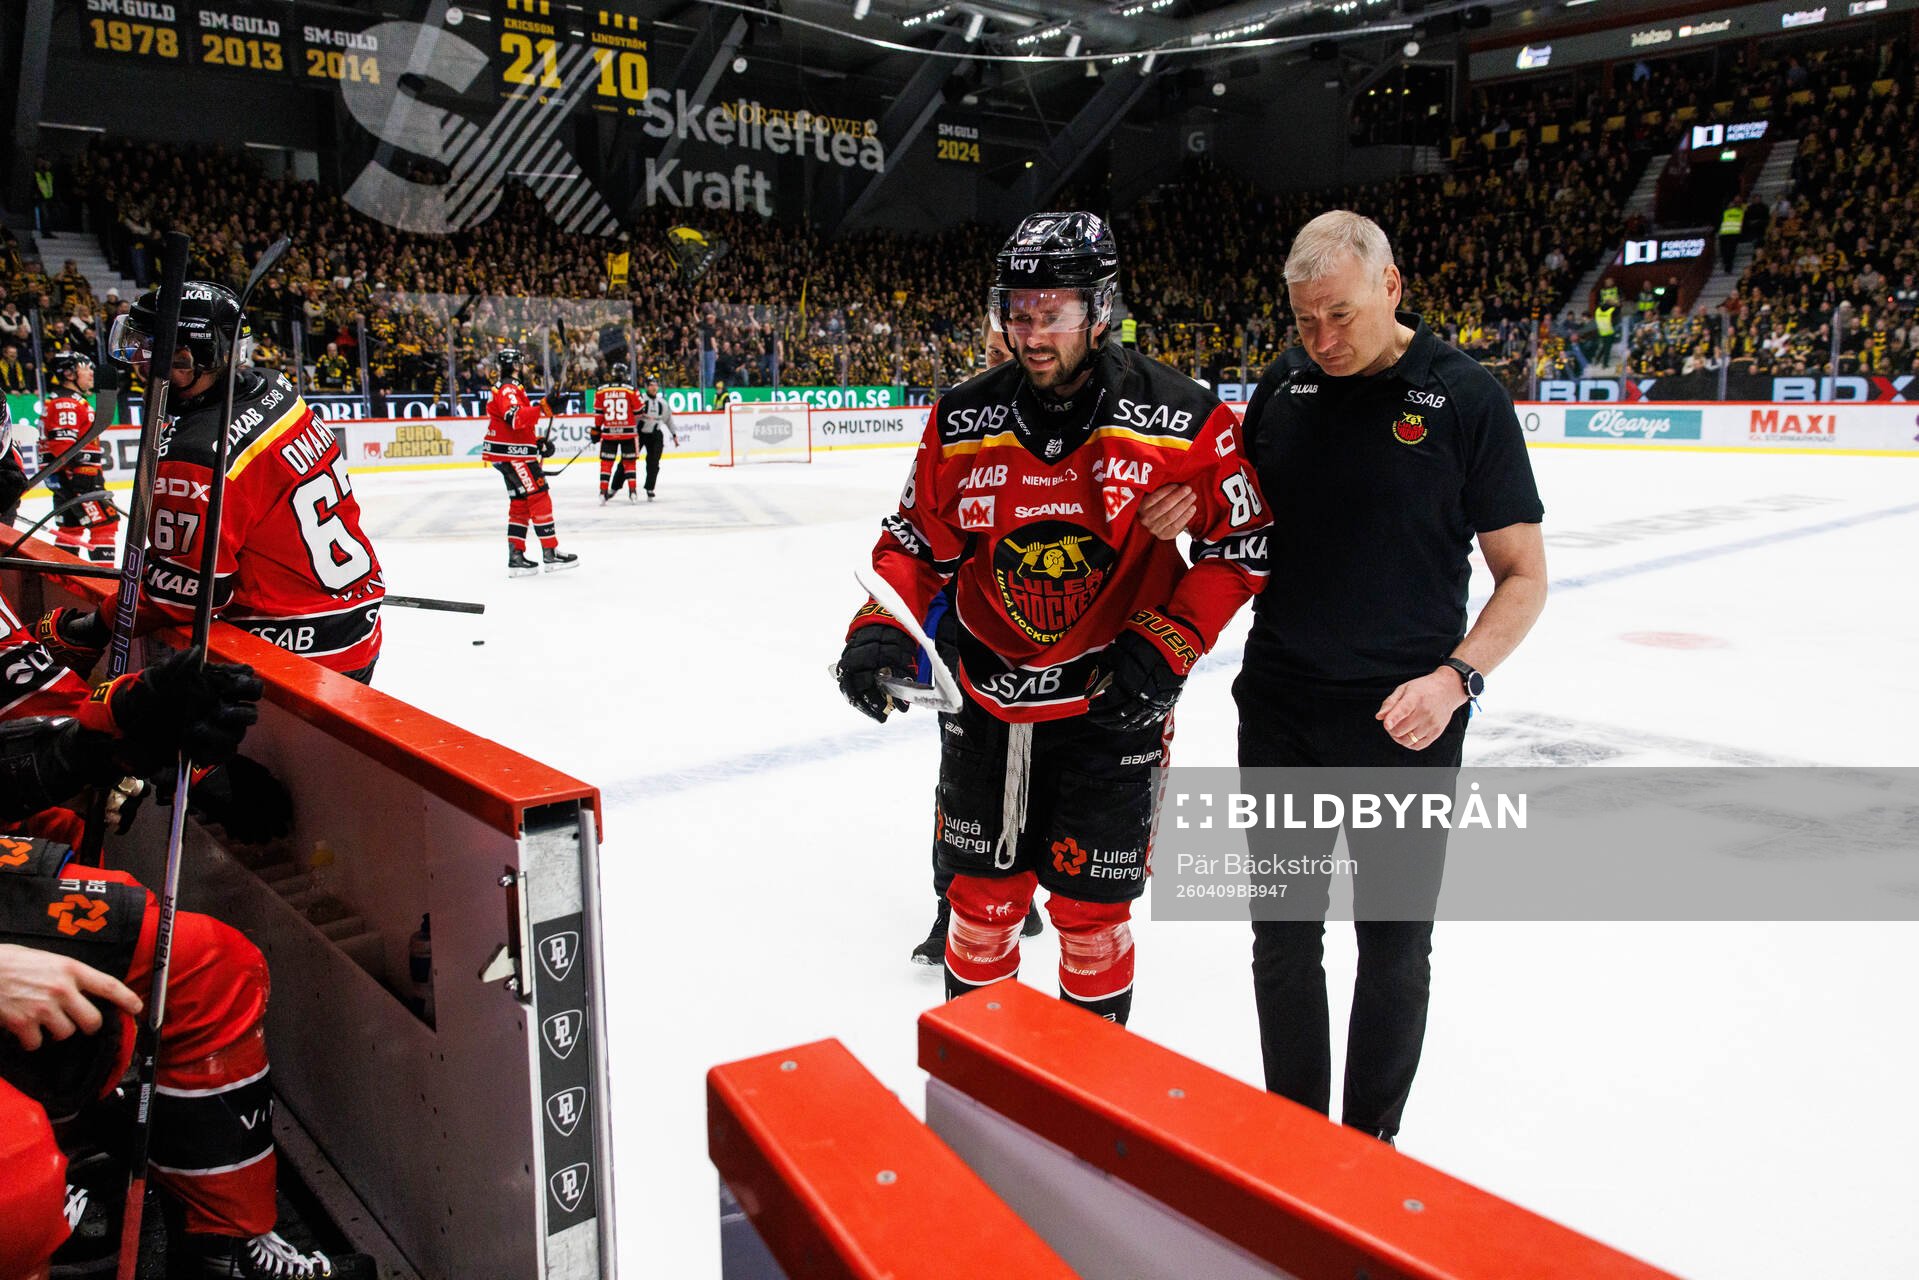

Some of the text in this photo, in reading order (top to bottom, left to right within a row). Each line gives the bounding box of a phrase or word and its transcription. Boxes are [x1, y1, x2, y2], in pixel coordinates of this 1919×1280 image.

[87, 0, 176, 22] SM-GULD
[199, 10, 281, 37] SM-GULD
[503, 17, 555, 35] ERICSSON
[90, 18, 179, 58] 1978
[303, 26, 378, 51] SM-GULD
[591, 32, 648, 51] LINDSTRÖM
[201, 34, 284, 71] 2013
[500, 32, 562, 89] 21
[306, 49, 381, 84] 2014
[593, 47, 649, 100] 10
[642, 87, 885, 174] Skellefteå
[1188, 131, 1205, 152] G
[937, 139, 980, 163] 2024
[645, 157, 773, 217] Kraft
[1010, 256, 1040, 274] kry
[261, 389, 285, 410] SSAB
[1404, 389, 1446, 409] SSAB
[1539, 379, 1657, 402] BDX
[1771, 375, 1916, 403] BDX
[58, 411, 78, 426] 29
[603, 398, 629, 420] 39
[946, 405, 1009, 437] SSAB
[1112, 398, 1193, 432] SSAB
[229, 407, 264, 446] LKAB
[395, 424, 443, 442] EURO
[752, 423, 791, 437] FASTEC
[838, 418, 905, 435] HULTDINS
[1749, 409, 1837, 434] MAXI
[383, 438, 455, 459] JACKPOT
[507, 445, 529, 456] SSAB
[1022, 475, 1051, 487] NIEMI
[1014, 502, 1085, 519] SCANIA
[155, 508, 200, 553] 67
[1224, 536, 1269, 560] LKA
[148, 568, 200, 597] KAB
[1127, 609, 1199, 668] AUER
[981, 667, 1063, 700] SSAB
[1120, 749, 1163, 766] BAUER
[944, 812, 982, 836] Luleå
[944, 829, 991, 854] Energi
[1092, 848, 1138, 864] Luleå
[159, 895, 175, 960] BAUER
